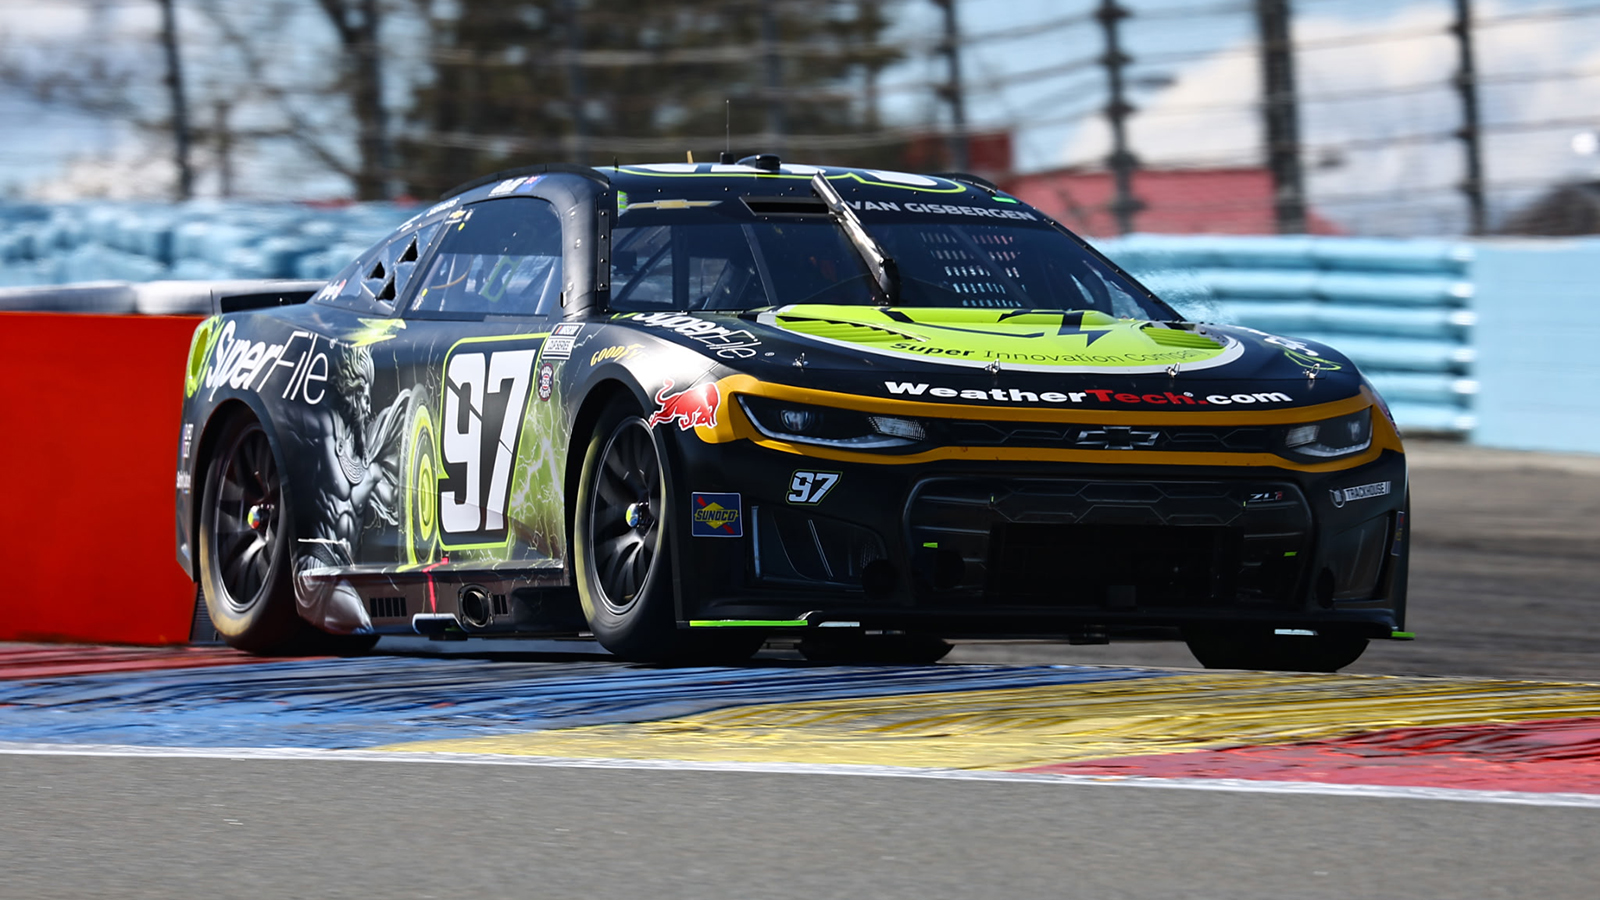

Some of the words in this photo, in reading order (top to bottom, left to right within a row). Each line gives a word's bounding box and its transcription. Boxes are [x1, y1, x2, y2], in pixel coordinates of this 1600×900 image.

[846, 200, 901, 212] VAN
[904, 202, 1038, 222] GISBERGEN
[890, 342, 976, 359] Super
[984, 350, 1125, 363] Innovation
[441, 349, 536, 533] 97
[788, 471, 839, 503] 97
[1345, 482, 1385, 500] TRACKHOUSE
[696, 510, 737, 521] SUNOCO
